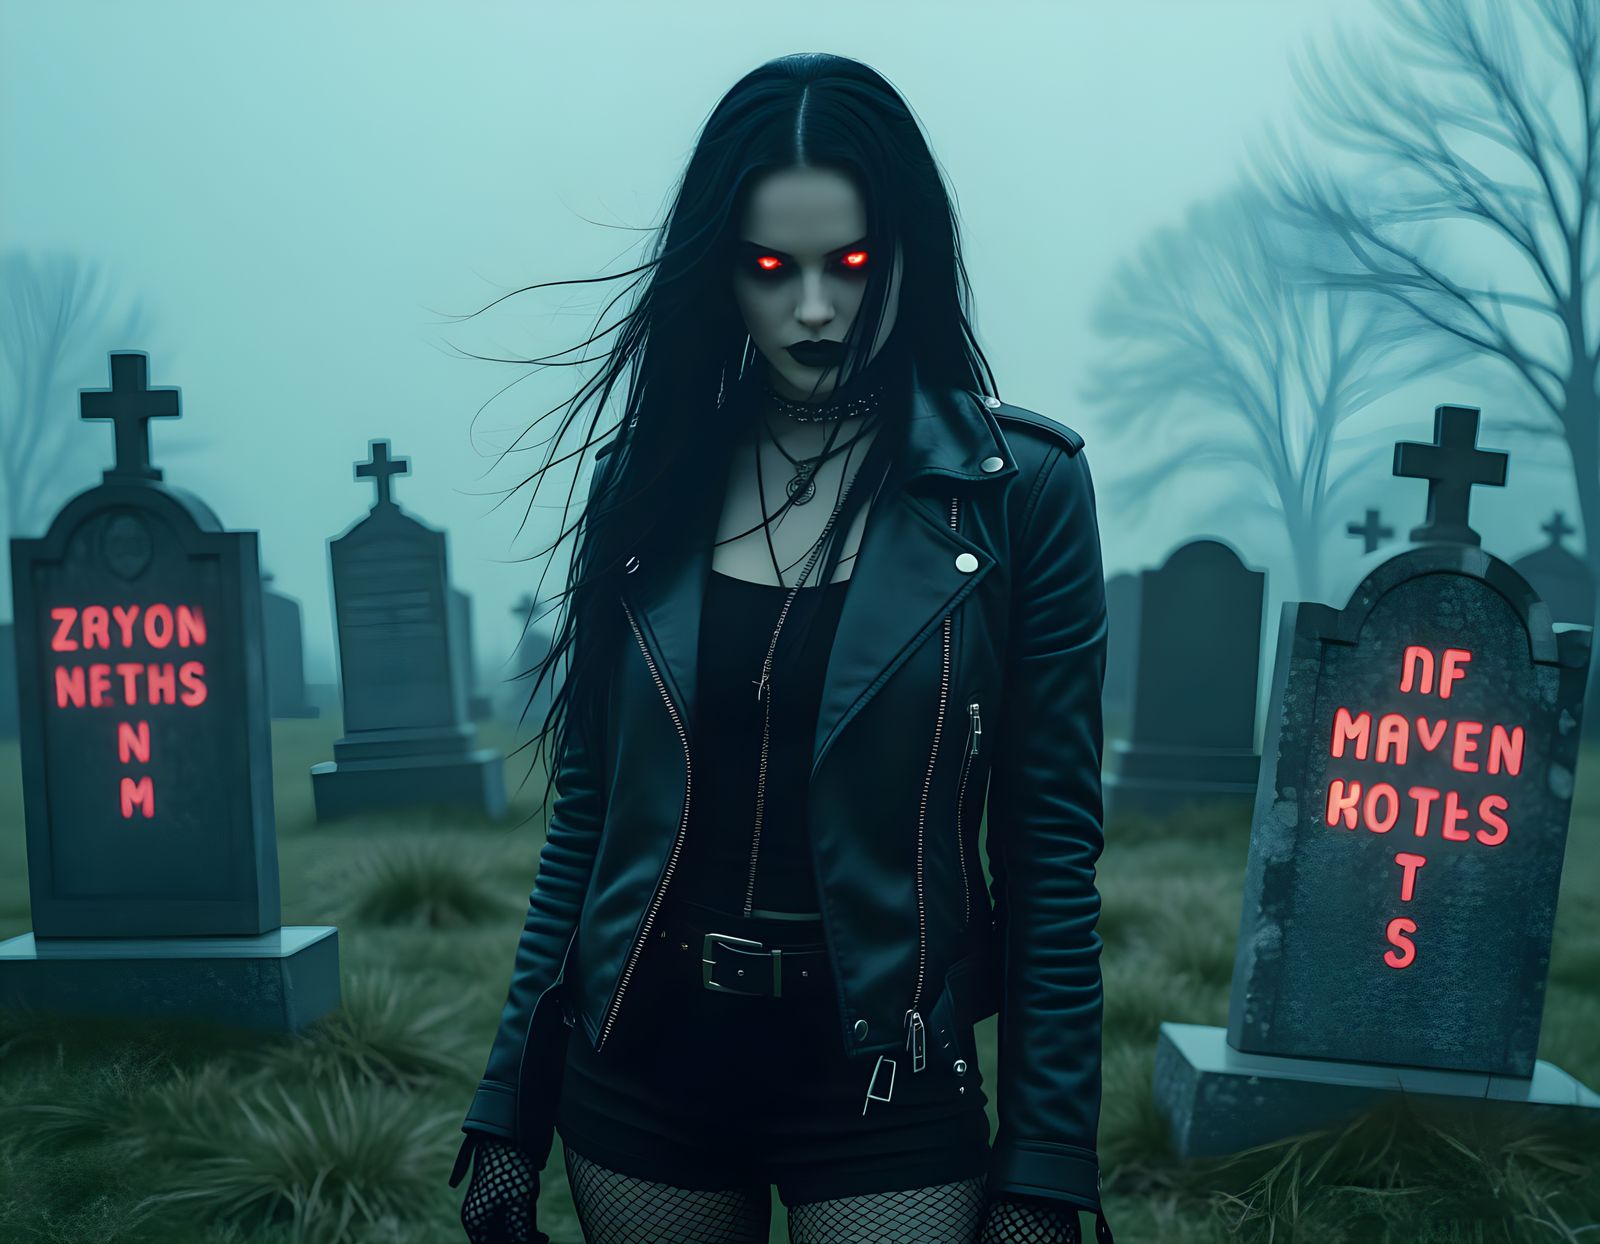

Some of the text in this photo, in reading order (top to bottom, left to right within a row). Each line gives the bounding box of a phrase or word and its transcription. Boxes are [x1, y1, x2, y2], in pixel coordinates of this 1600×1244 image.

[50, 603, 208, 652] ZAYON
[117, 720, 151, 764] N
[1330, 706, 1525, 776] MAVEN
[119, 776, 155, 819] M
[1394, 852, 1427, 902] T
[1382, 916, 1418, 969] S
